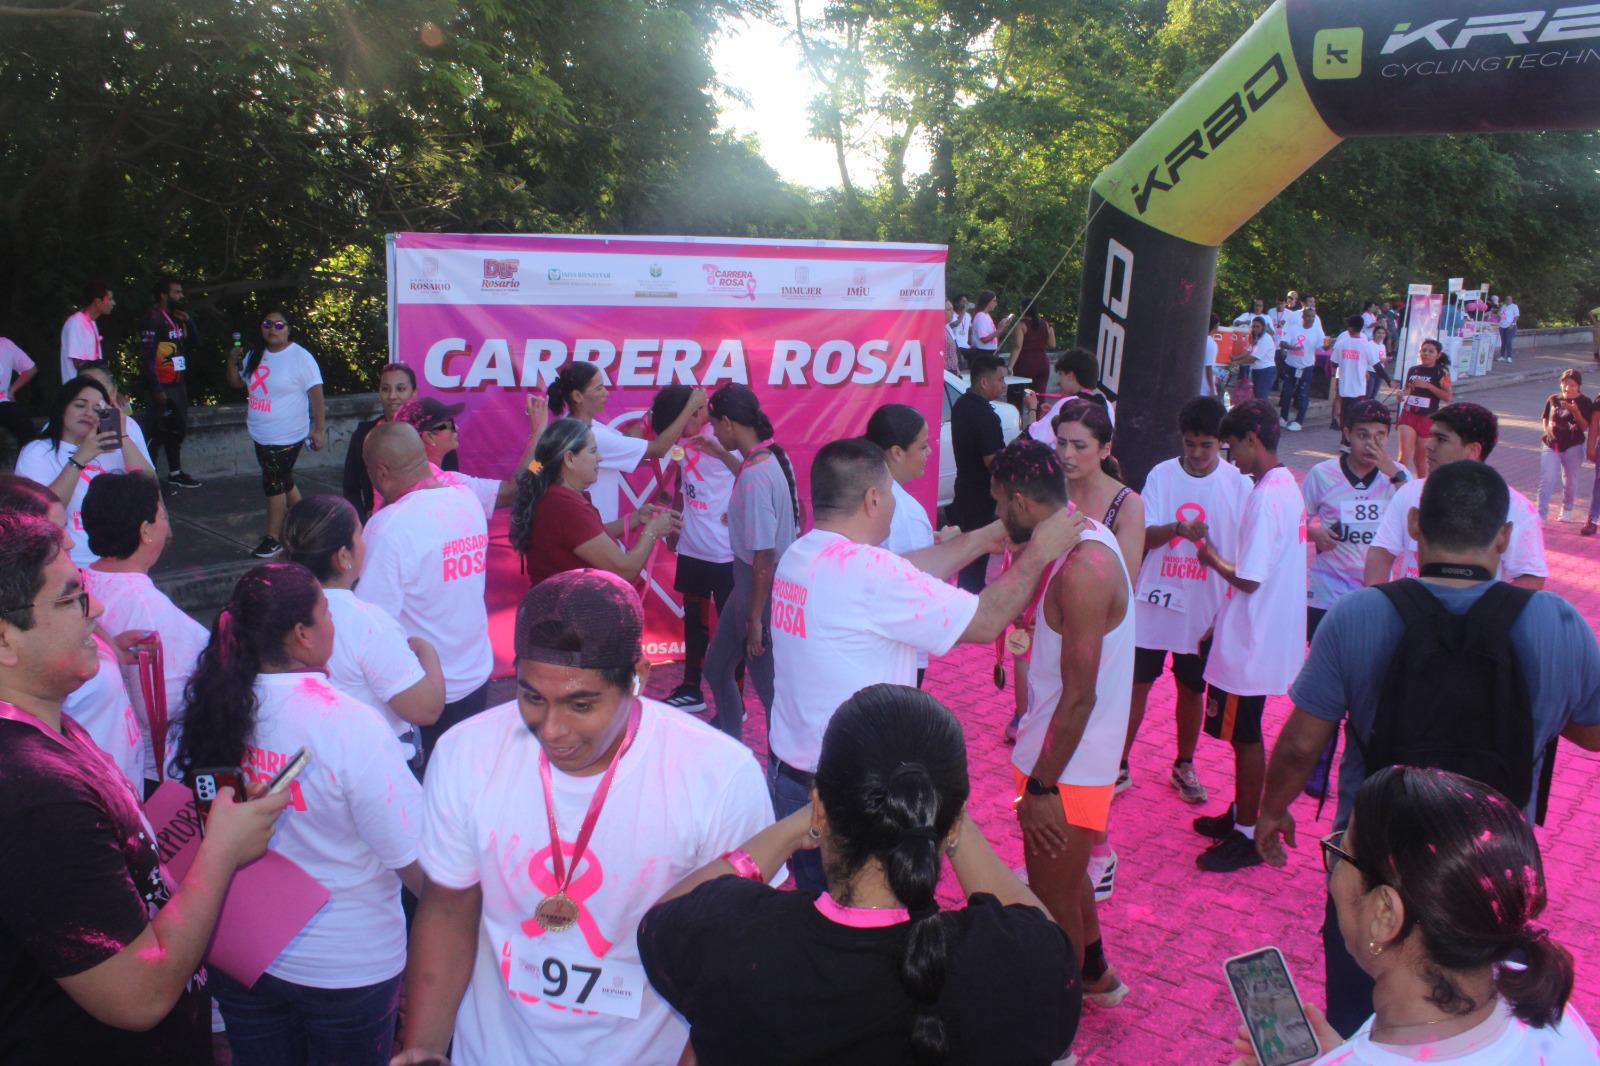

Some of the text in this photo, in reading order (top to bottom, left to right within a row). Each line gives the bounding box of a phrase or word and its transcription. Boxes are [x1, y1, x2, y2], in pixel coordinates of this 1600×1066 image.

[715, 270, 753, 279] CARRERA
[719, 279, 745, 287] ROSA
[410, 282, 451, 292] ROSARIO
[481, 279, 520, 289] Rosario
[423, 337, 926, 388] CARRERA ROSA
[1355, 504, 1379, 521] 88
[1341, 525, 1377, 544] Jee
[1161, 562, 1208, 581] LUCHA
[1147, 589, 1172, 608] 61
[542, 957, 602, 1004] 97
